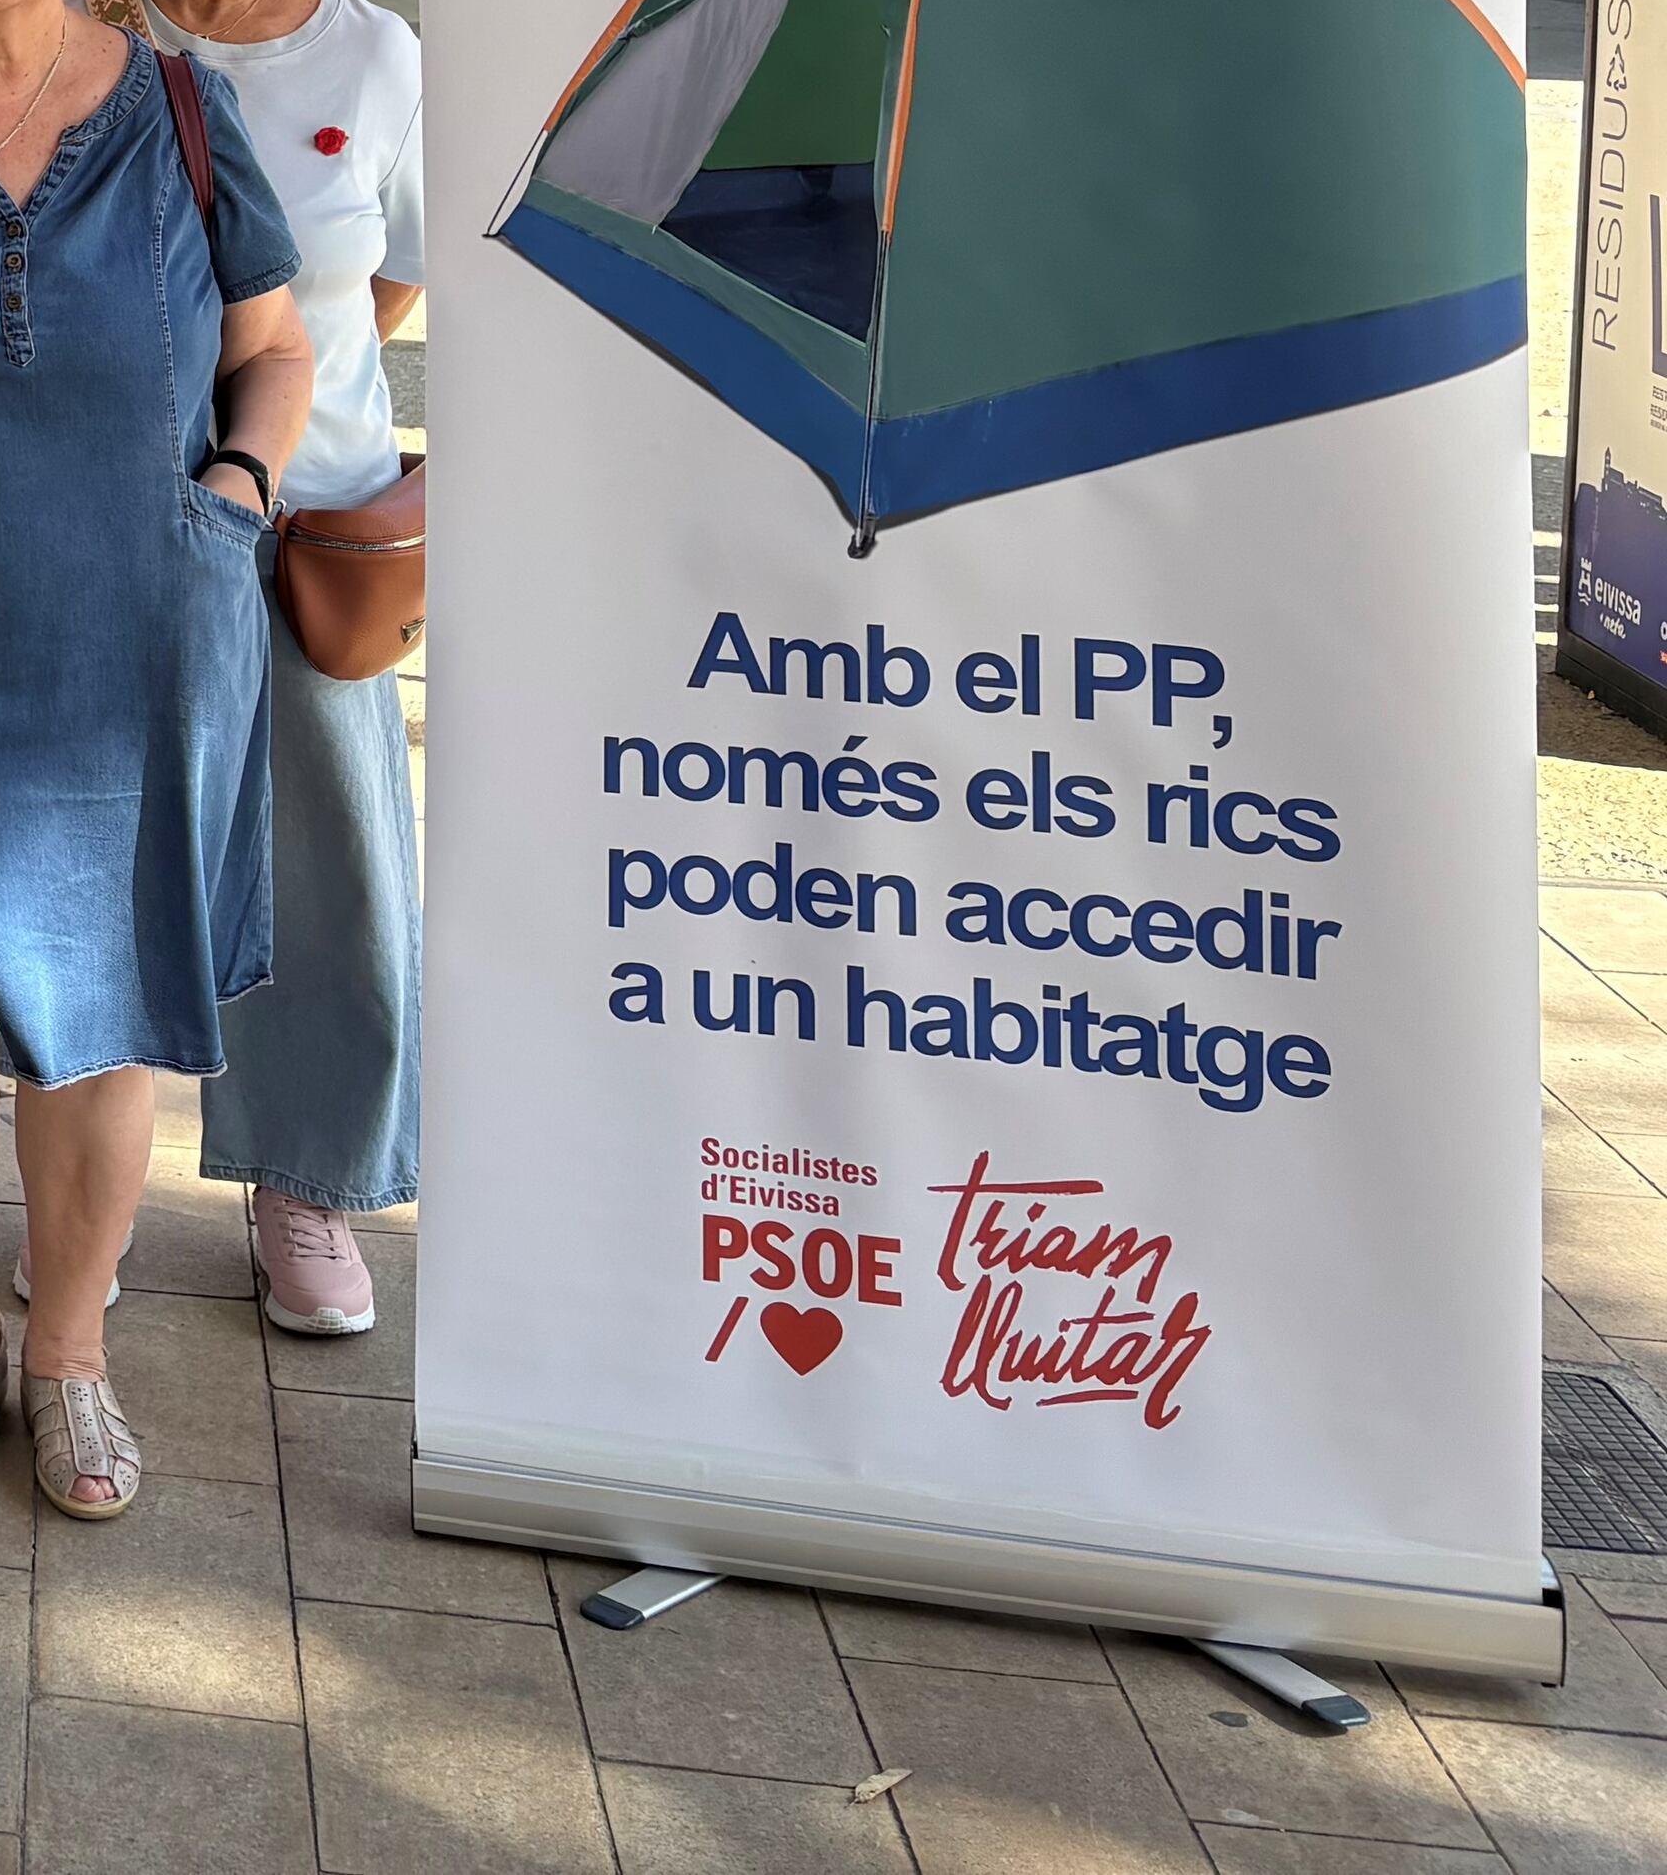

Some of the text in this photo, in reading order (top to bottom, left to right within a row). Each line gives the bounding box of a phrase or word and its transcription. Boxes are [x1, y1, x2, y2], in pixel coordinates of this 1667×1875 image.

[687, 610, 1234, 750] Amb el PP,
[602, 734, 1342, 863] només els rics
[607, 842, 1343, 981] poden accedir
[609, 959, 1332, 1113] a un habitatge
[700, 1136, 878, 1187] Socialistes
[700, 1173, 840, 1218] d'Eivissa
[702, 1213, 903, 1308] PSOE
